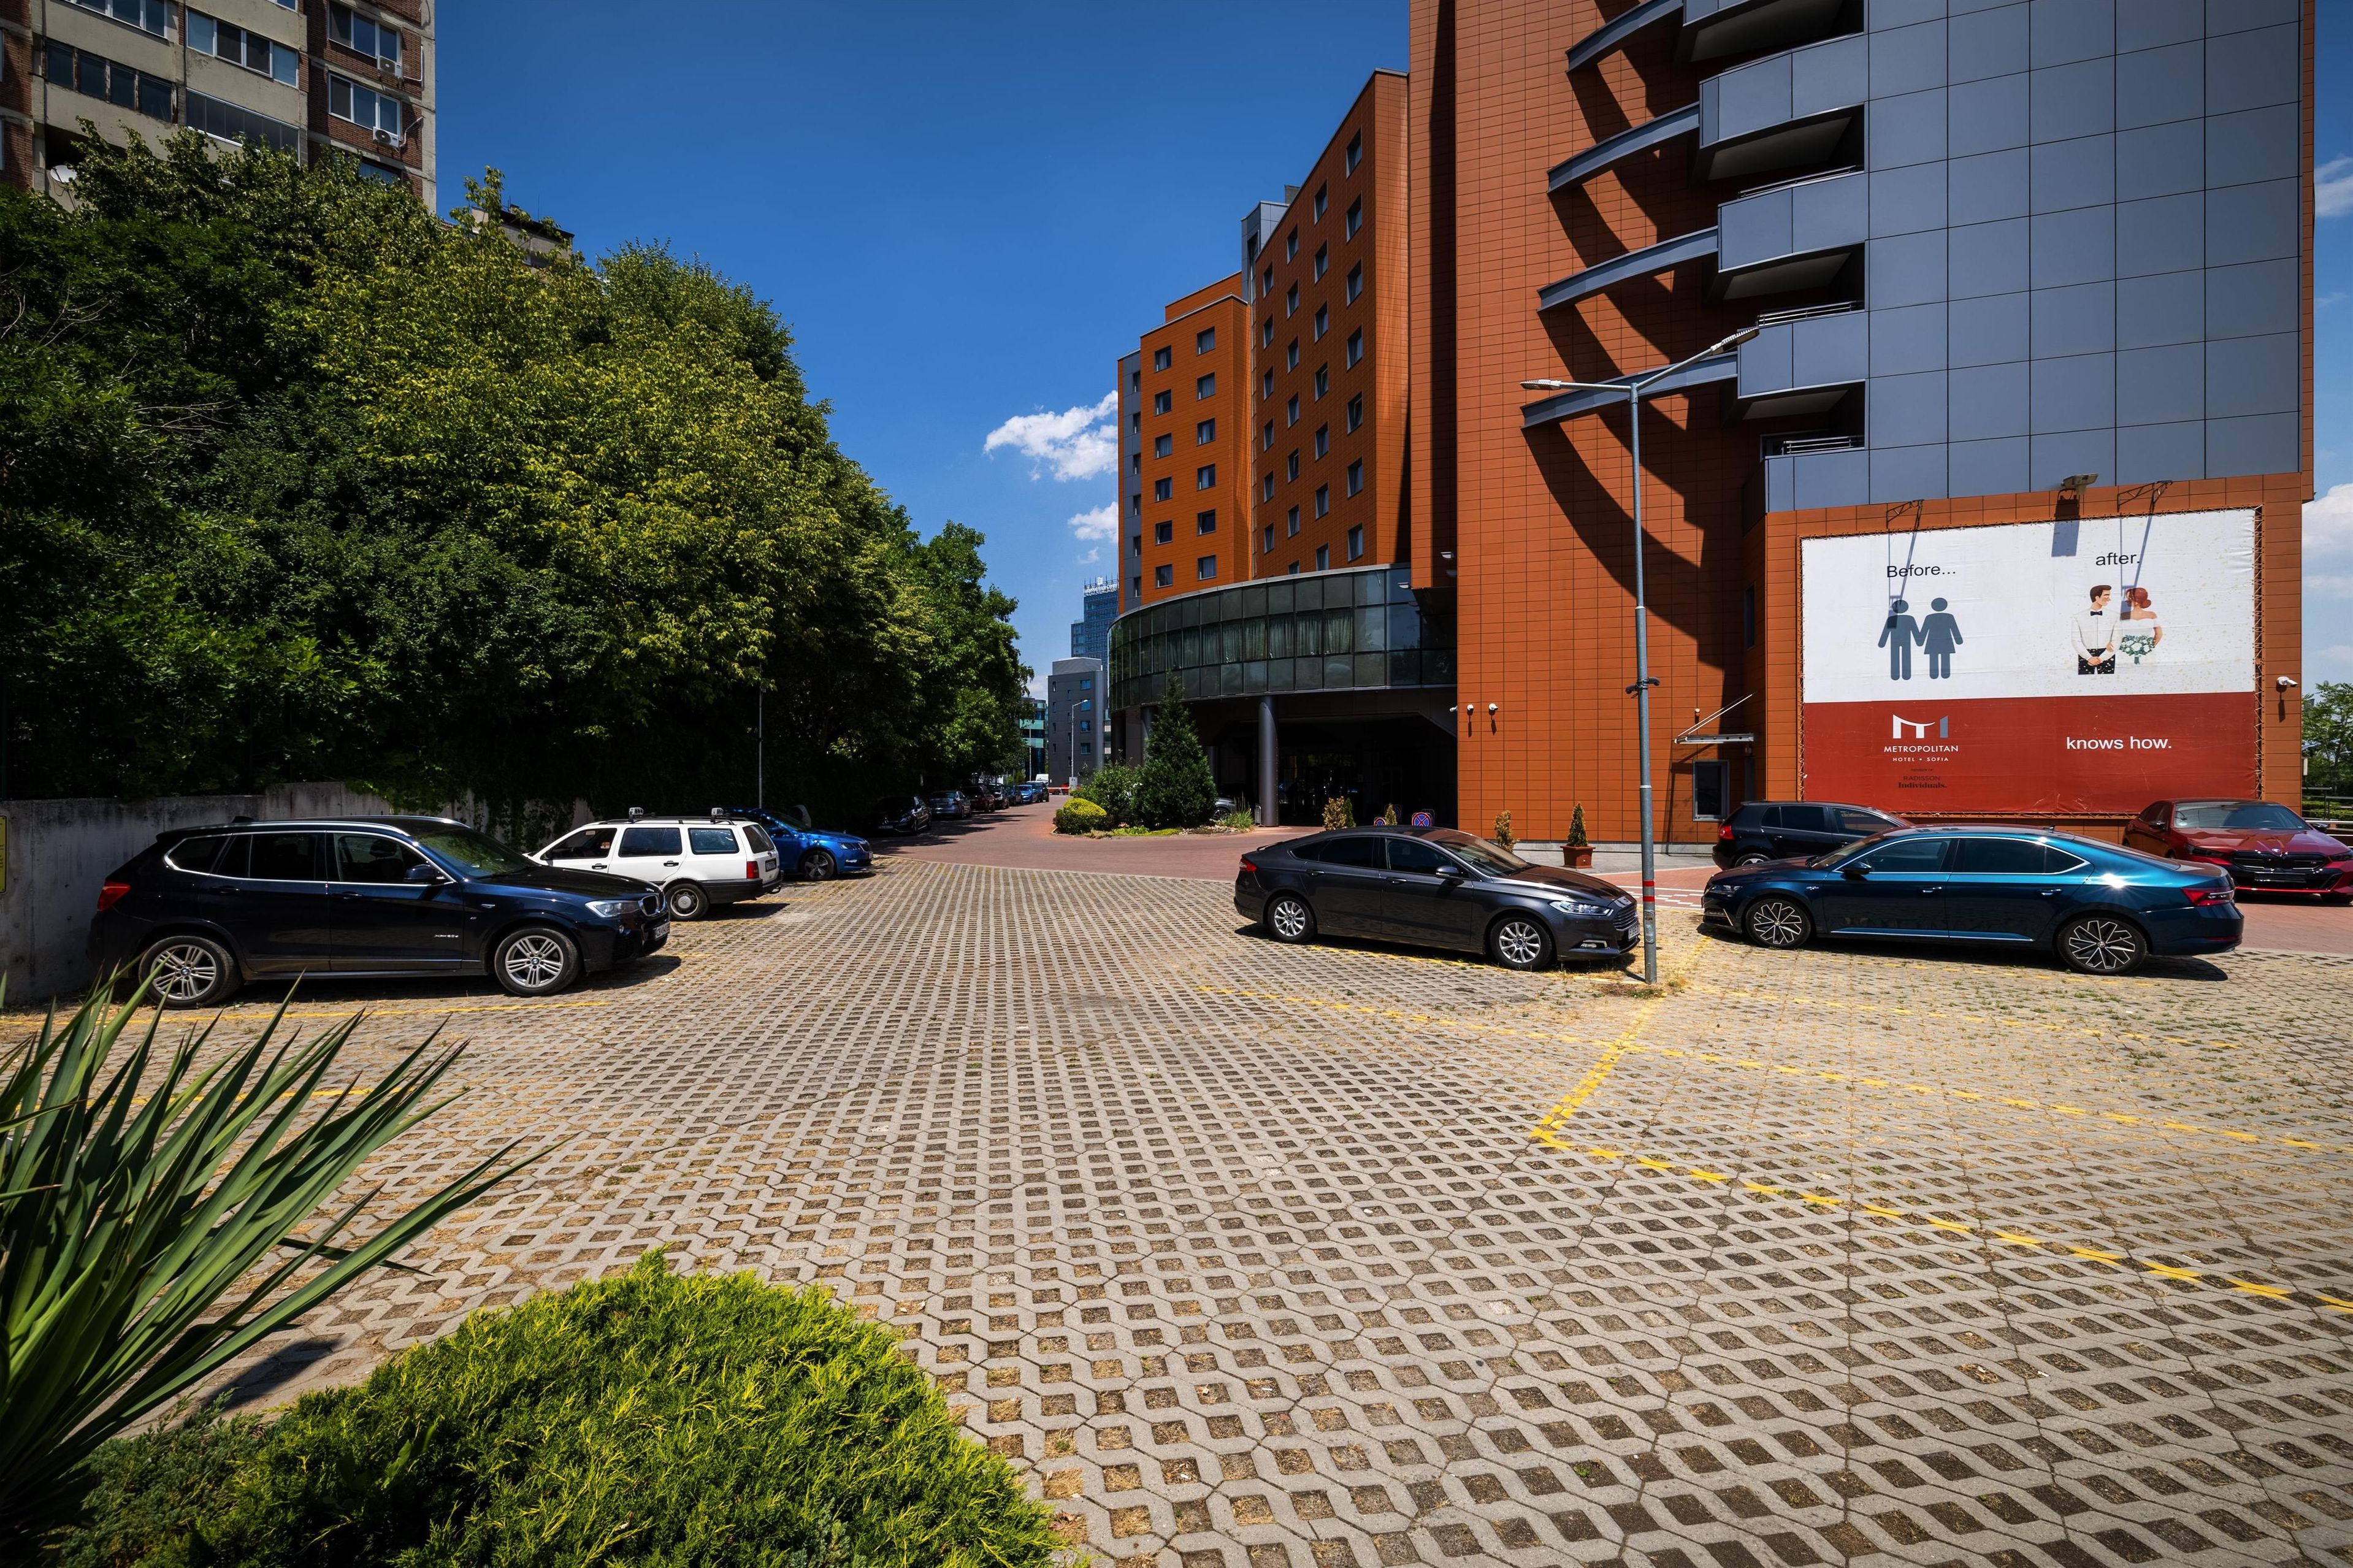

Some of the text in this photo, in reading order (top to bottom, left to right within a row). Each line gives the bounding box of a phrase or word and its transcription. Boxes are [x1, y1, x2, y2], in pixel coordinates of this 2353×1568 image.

[2095, 552, 2140, 565] after.
[1887, 564, 1956, 578] Before...
[2067, 736, 2172, 749] knows how.
